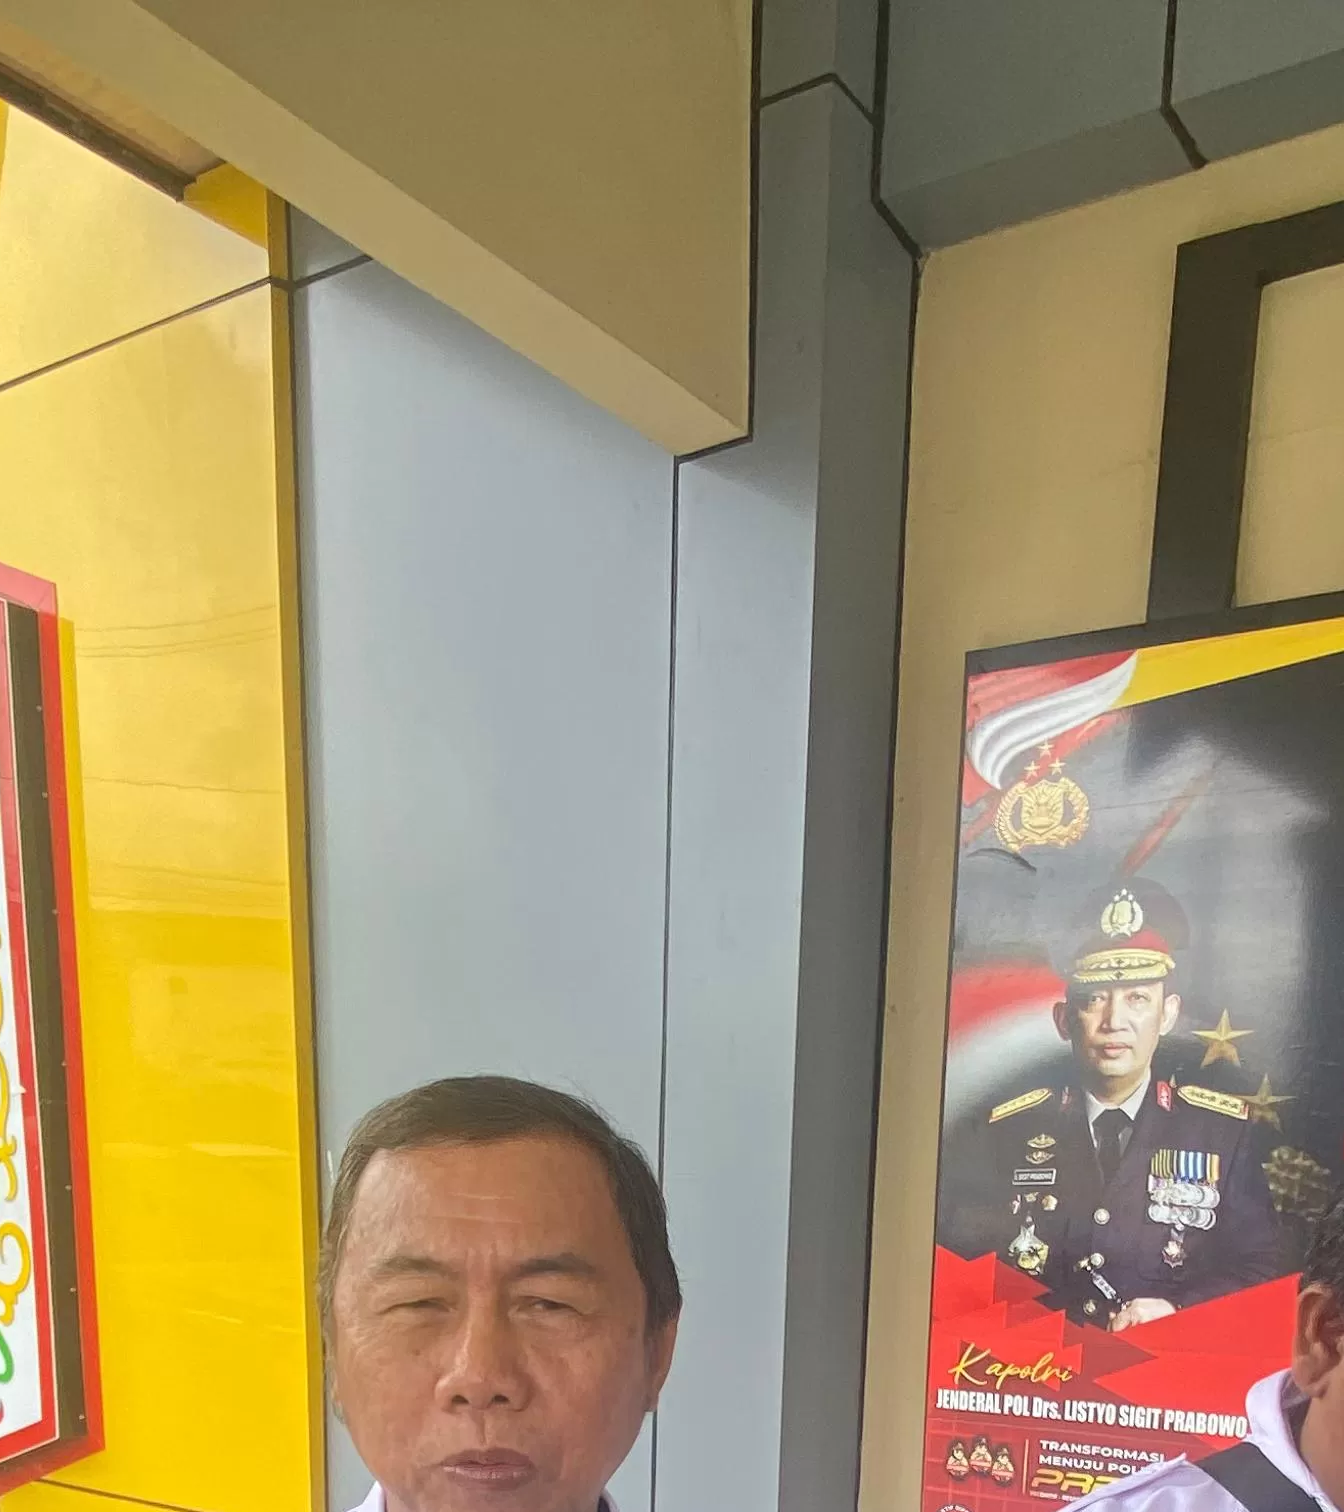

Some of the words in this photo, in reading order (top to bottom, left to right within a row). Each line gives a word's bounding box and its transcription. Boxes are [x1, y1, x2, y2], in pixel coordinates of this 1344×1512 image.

[947, 1342, 1074, 1391] Kapolri
[935, 1388, 1002, 1414] JENDERAL
[1003, 1394, 1032, 1417] POL
[1032, 1397, 1062, 1420] Drs.
[1064, 1399, 1116, 1427] LISTYO
[1119, 1404, 1162, 1431] SIGIT
[1163, 1408, 1248, 1438] PRABOWO
[1038, 1454, 1104, 1472] MENUJU
[1039, 1439, 1166, 1464] TRANSFORMASI
